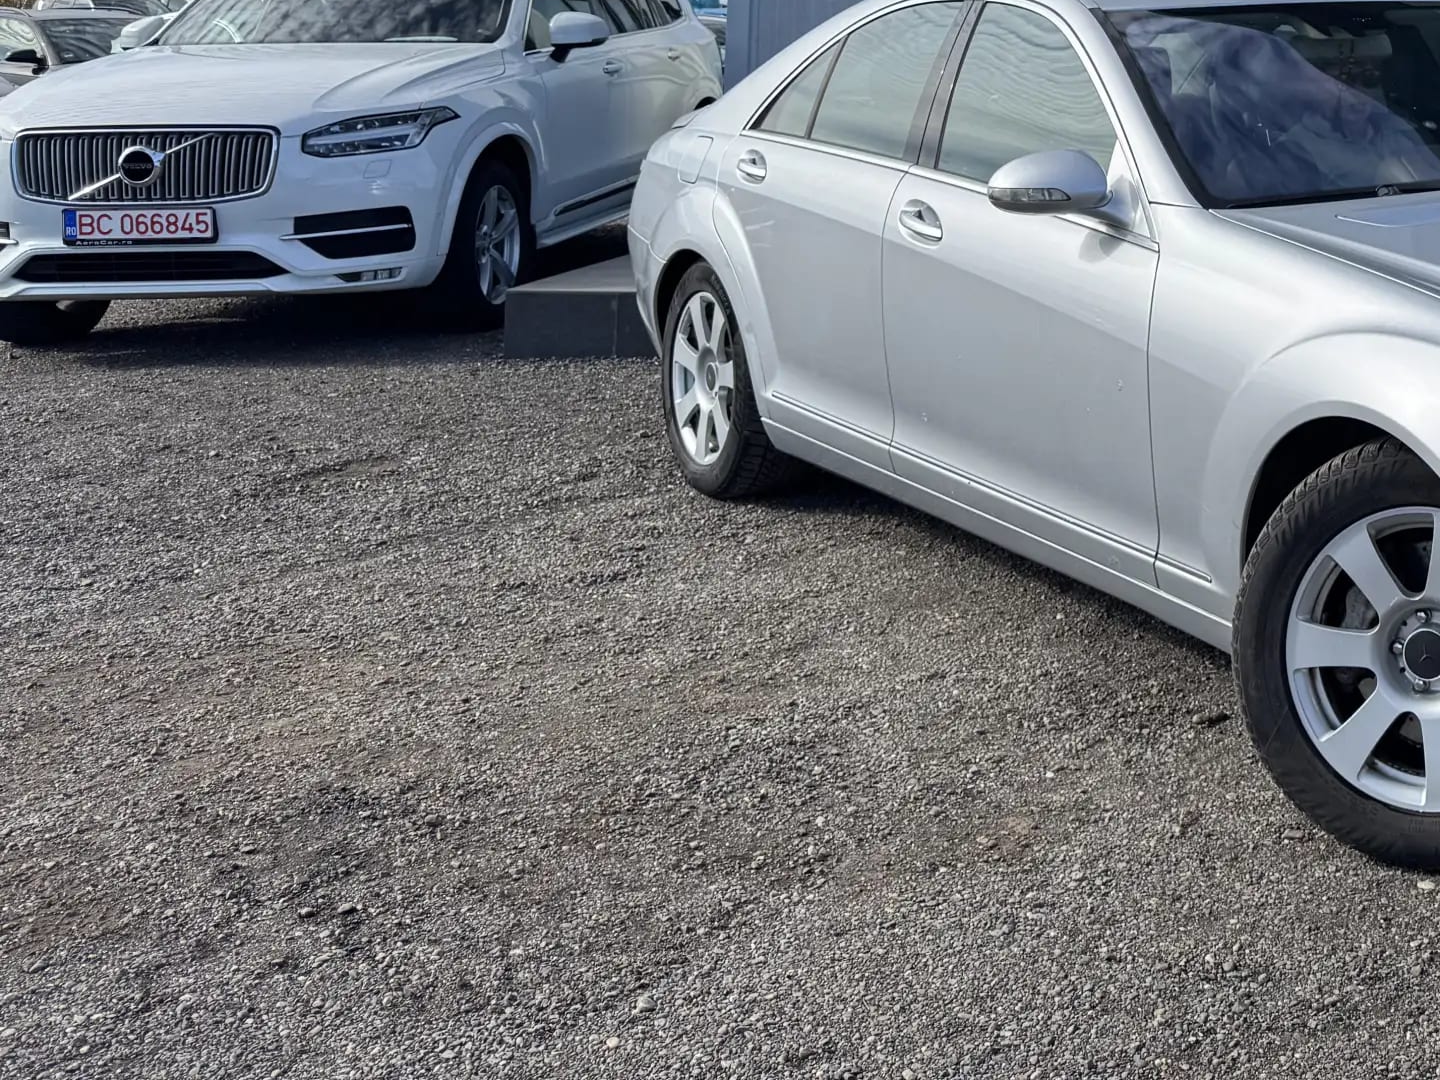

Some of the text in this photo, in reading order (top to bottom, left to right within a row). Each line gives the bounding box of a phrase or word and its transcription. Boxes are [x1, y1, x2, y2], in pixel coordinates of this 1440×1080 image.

[66, 226, 77, 236] RO
[78, 212, 209, 235] BC 066845
